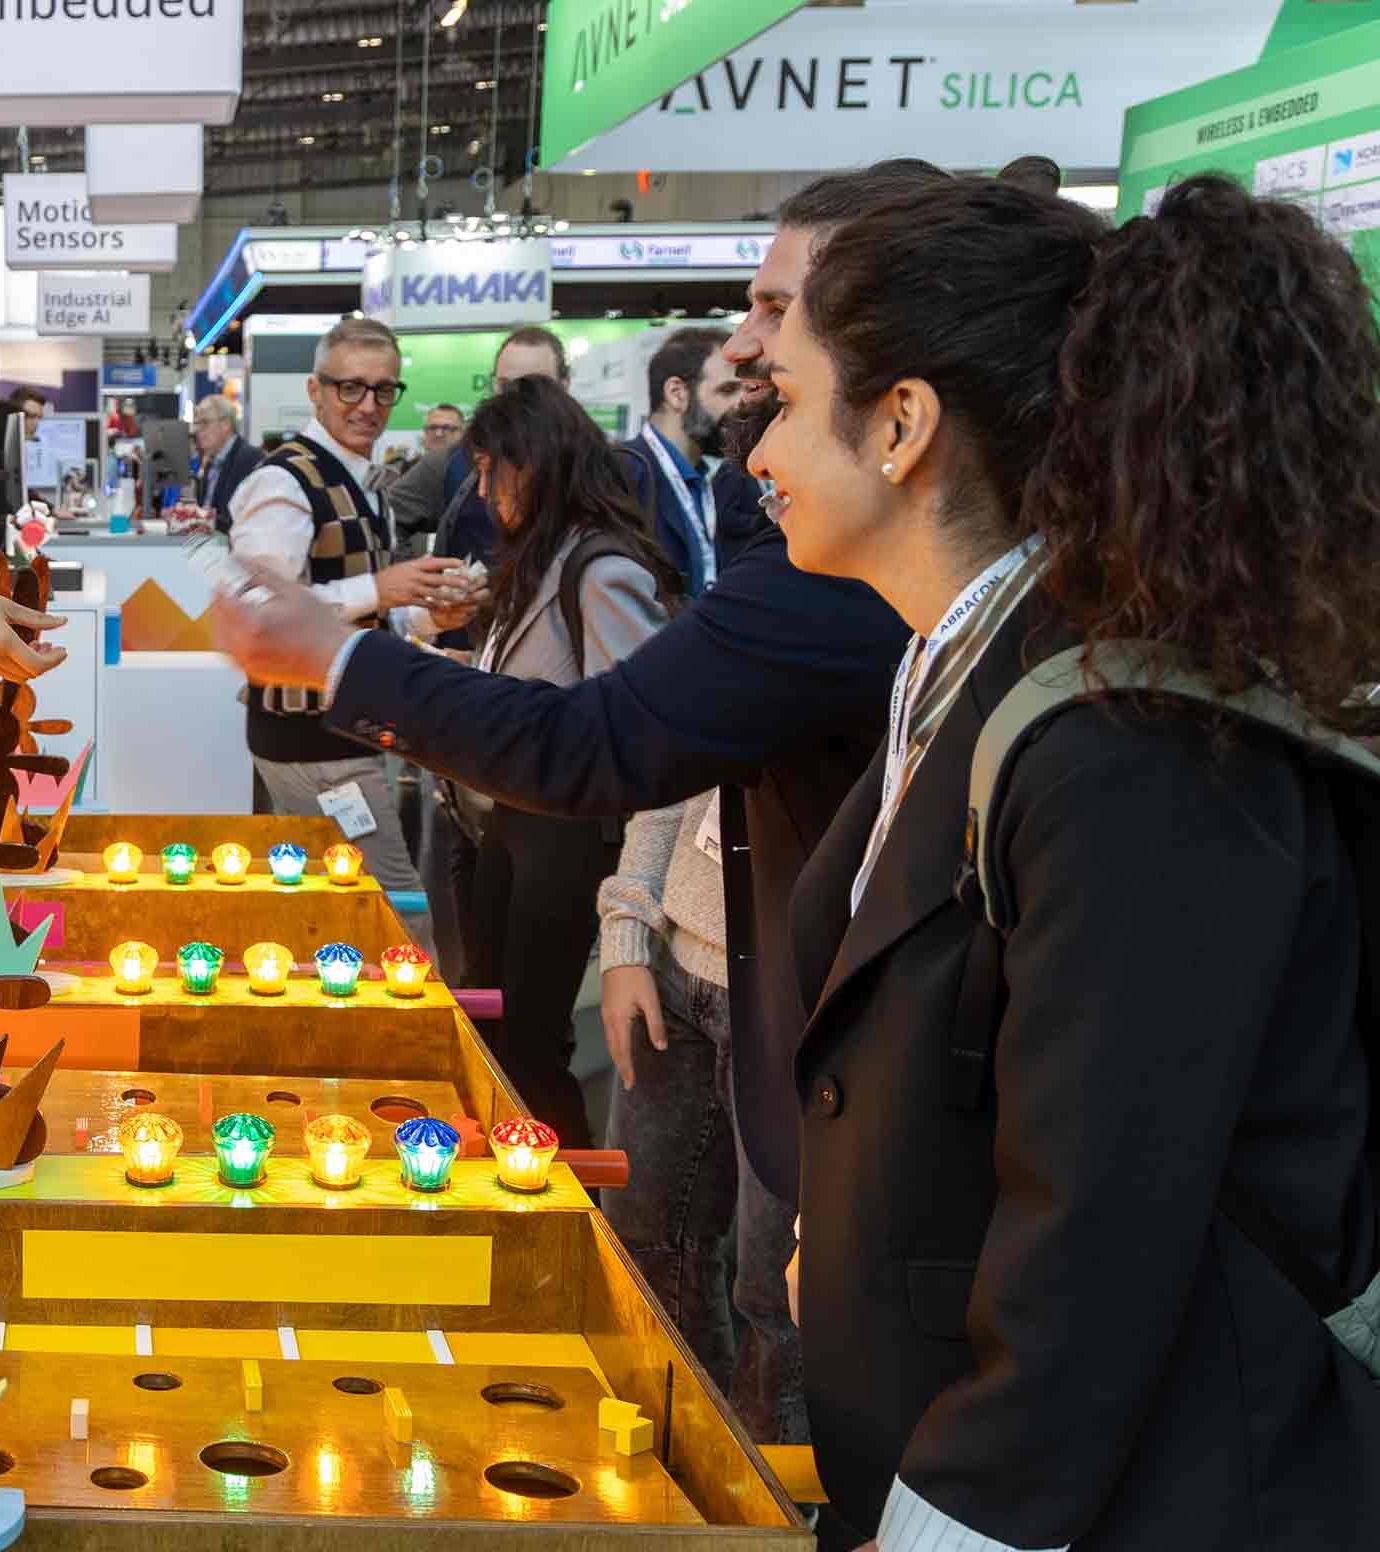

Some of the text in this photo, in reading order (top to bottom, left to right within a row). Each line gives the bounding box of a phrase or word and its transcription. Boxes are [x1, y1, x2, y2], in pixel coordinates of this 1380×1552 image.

[940, 72, 1083, 108] SILICA
[1196, 114, 1245, 144] WIRELESS
[1259, 92, 1318, 128] EMBEDDED
[17, 200, 93, 223] Motio
[16, 227, 124, 249] Sensors
[44, 290, 132, 307] Industrial
[400, 270, 547, 306] KAMAKA
[45, 309, 110, 328] Edge AI
